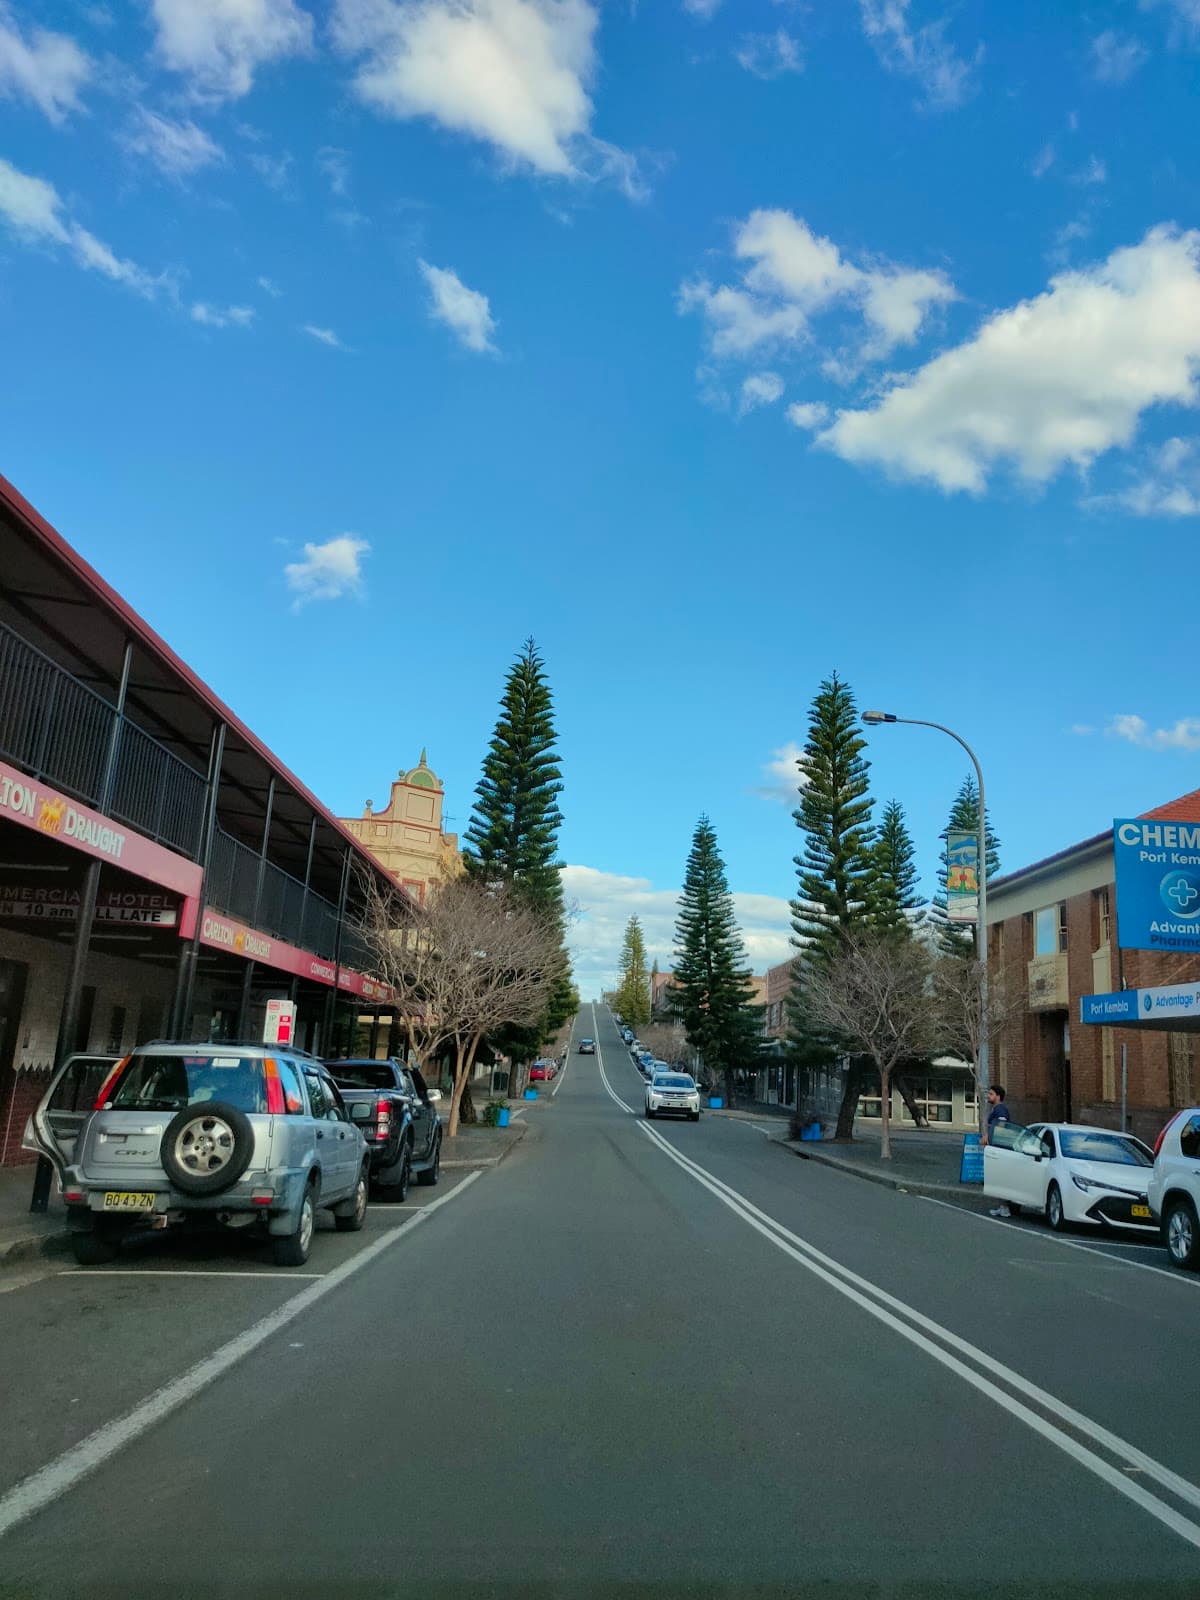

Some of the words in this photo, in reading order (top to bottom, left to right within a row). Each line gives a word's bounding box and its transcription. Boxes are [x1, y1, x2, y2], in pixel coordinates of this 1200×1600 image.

[0, 776, 37, 818] TON
[64, 807, 125, 857] DRAUGHT
[1118, 823, 1200, 849] CHEM
[1139, 850, 1167, 863] Port
[1171, 852, 1200, 865] Kem
[0, 887, 82, 903] MERCIA
[108, 892, 174, 908] HOTEL
[25, 903, 44, 916] 10
[120, 909, 161, 922] LATE
[203, 918, 234, 946] CARLTON
[1150, 920, 1200, 935] Advant
[1090, 1001, 1104, 1015] Port
[1104, 998, 1129, 1013] Kembla
[1156, 993, 1194, 1008] Advantage
